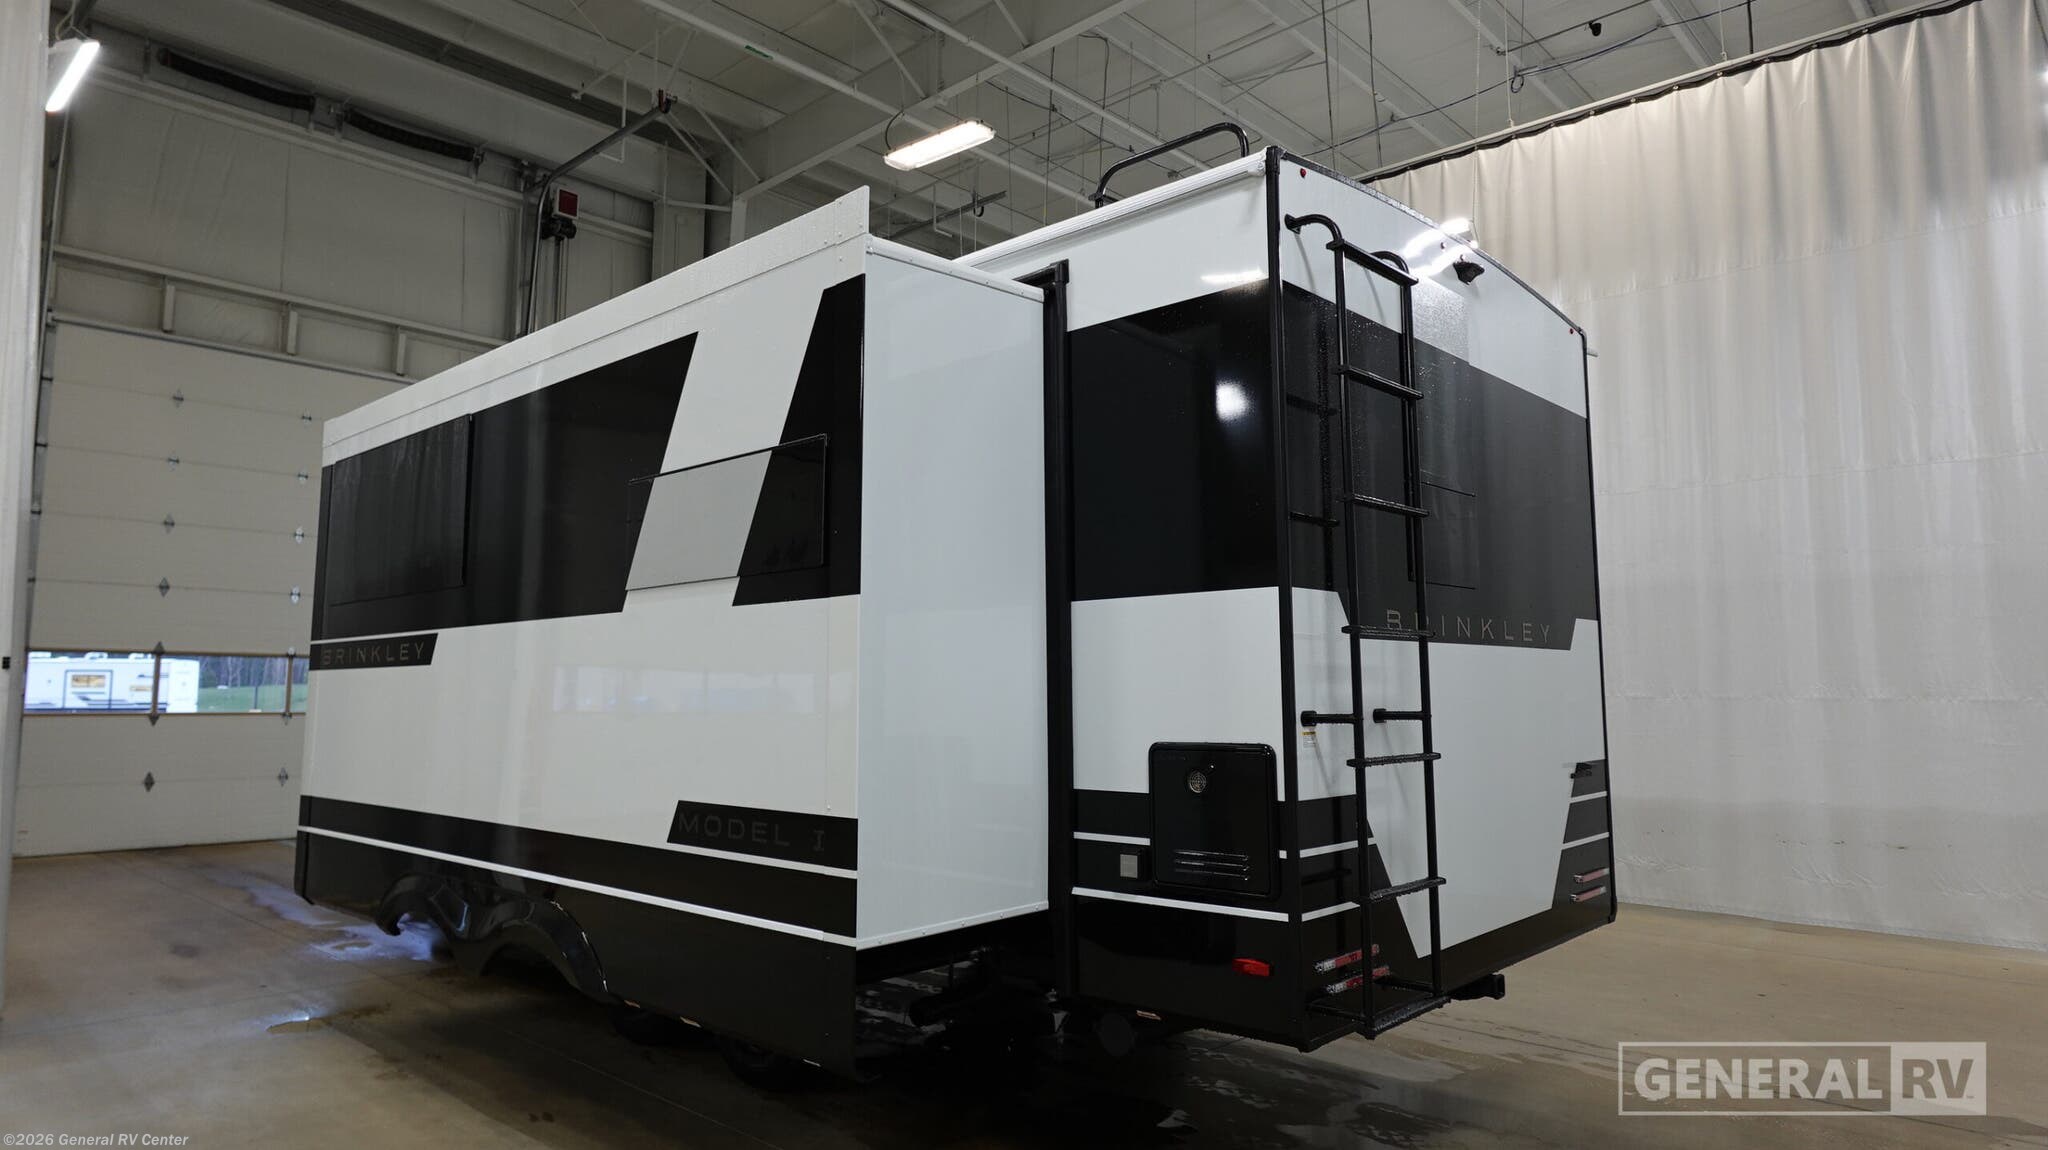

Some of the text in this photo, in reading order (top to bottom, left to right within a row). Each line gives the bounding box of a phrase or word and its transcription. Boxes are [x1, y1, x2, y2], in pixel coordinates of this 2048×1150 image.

[1386, 609, 1551, 643] BINKLEY
[321, 641, 425, 666] BRINKLEY
[677, 811, 791, 848] MODEL
